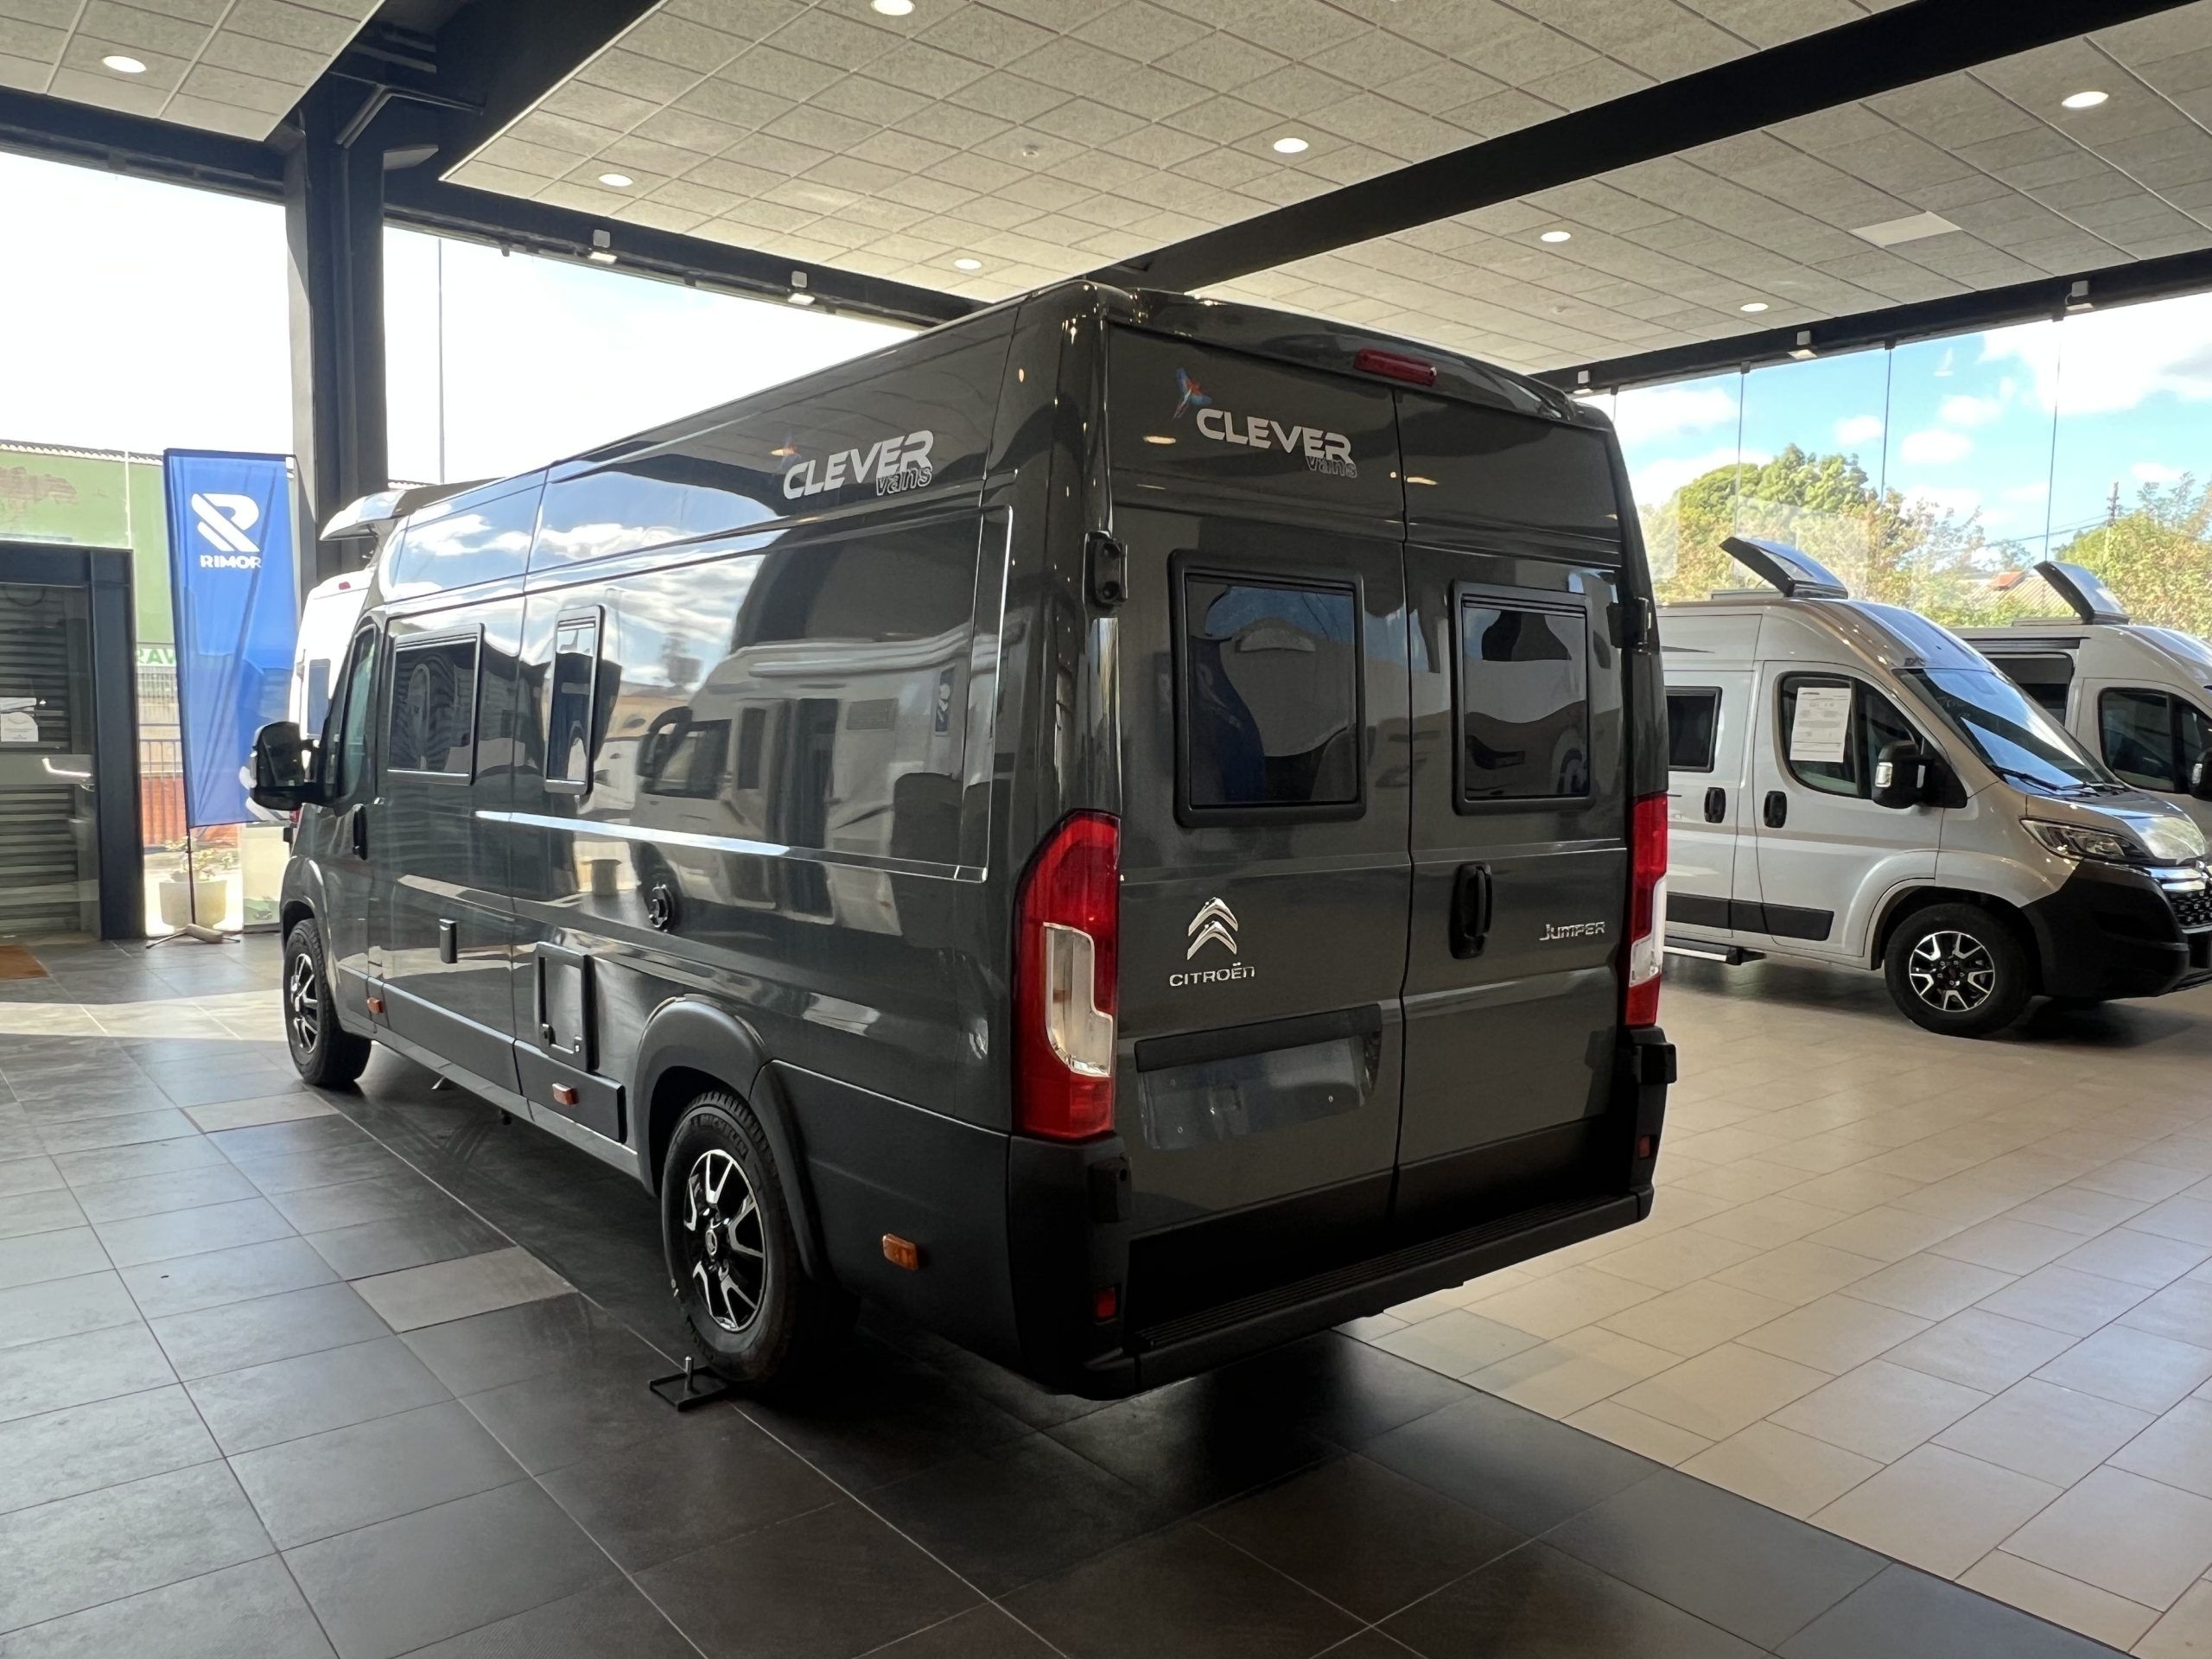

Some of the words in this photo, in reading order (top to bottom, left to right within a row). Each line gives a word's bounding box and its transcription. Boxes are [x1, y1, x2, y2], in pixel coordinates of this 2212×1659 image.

[1196, 408, 1357, 465] CLEVER
[783, 429, 934, 499] CLEVER
[1306, 454, 1357, 478] vans
[875, 466, 932, 497] vans
[200, 554, 263, 569] RIMOR
